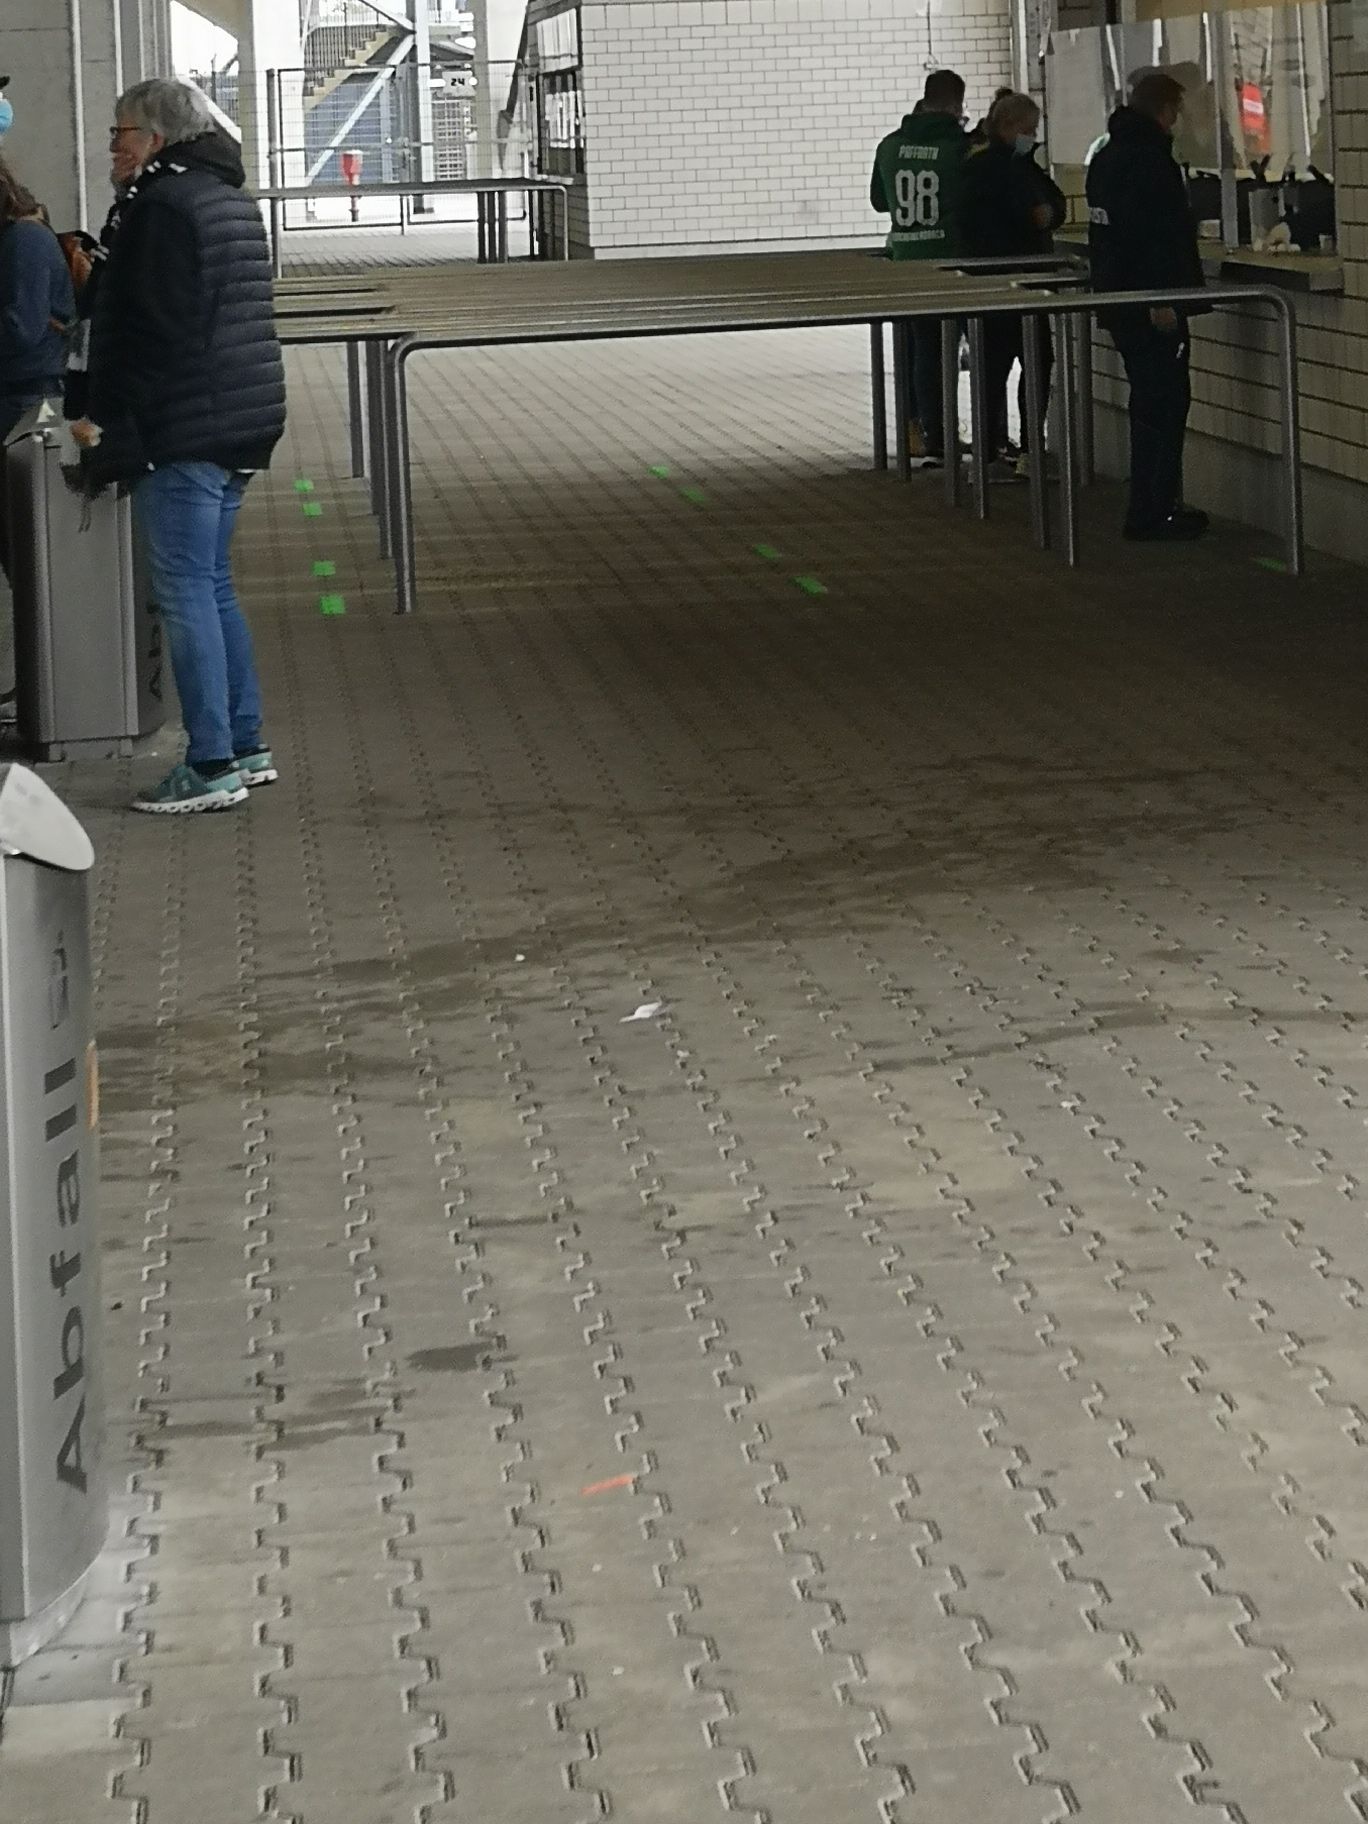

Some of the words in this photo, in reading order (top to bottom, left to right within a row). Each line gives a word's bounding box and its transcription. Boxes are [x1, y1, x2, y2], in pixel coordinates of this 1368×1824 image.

[450, 77, 465, 86] 24
[895, 169, 940, 227] 98
[44, 1056, 88, 1495] Abfall
